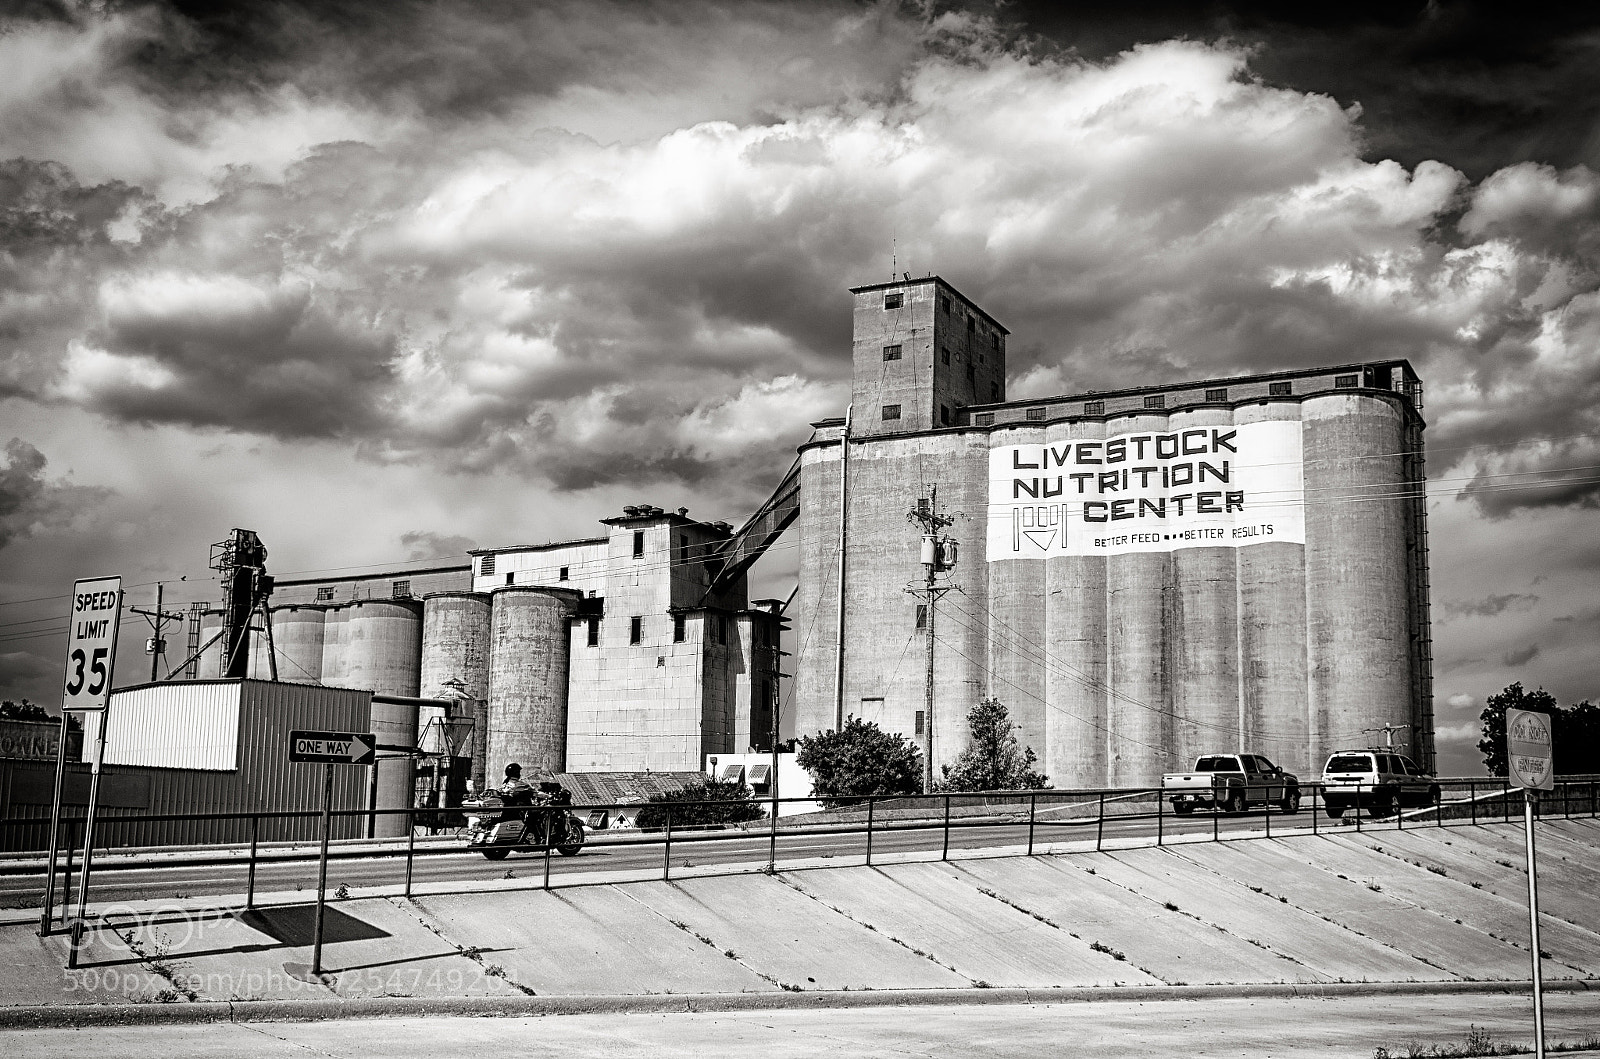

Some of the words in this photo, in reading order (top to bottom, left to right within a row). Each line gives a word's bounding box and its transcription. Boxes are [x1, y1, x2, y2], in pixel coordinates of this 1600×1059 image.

[1013, 429, 1237, 470] LIVESTOCK
[1013, 461, 1229, 498] NUTRITION
[1083, 490, 1244, 522] CENTER
[1094, 535, 1128, 547] BETTER
[1131, 533, 1160, 544] FEED
[1232, 524, 1274, 539] RESULTS
[75, 591, 116, 612] SPEED
[77, 620, 109, 639] LIMIT
[66, 647, 109, 696] 35
[298, 740, 322, 753] ONE
[326, 741, 352, 754] WAY
